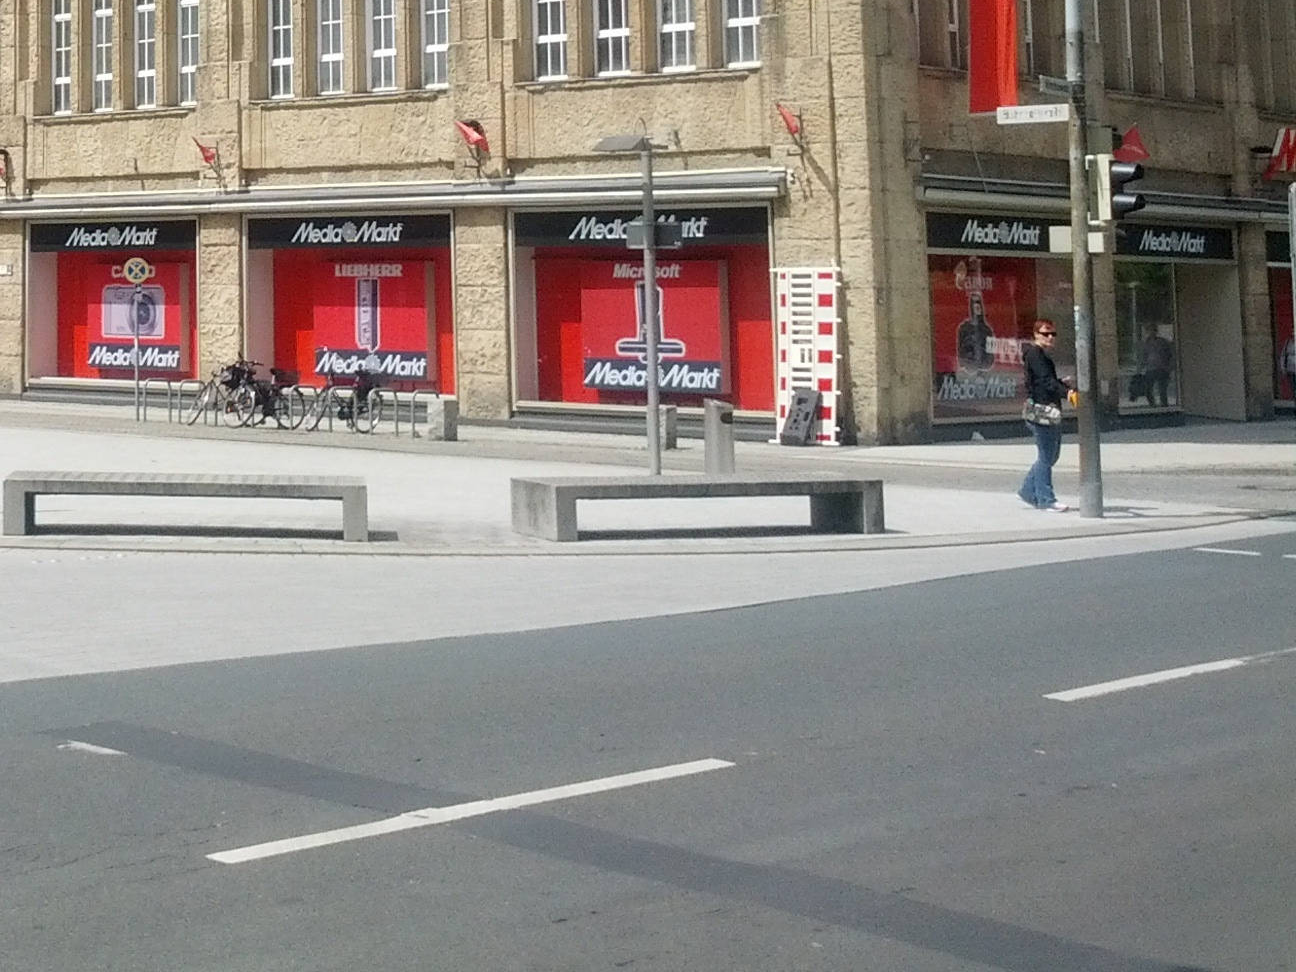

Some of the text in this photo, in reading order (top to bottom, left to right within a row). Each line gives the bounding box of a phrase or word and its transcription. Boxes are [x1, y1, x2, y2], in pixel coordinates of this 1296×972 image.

[65, 226, 157, 246] Media Markt
[291, 221, 403, 243] Media Markt
[961, 219, 1040, 245] Media Markt
[1139, 229, 1205, 253] Media Markt
[334, 264, 403, 277] LIEBHERR
[613, 263, 680, 278] Micrsoft
[87, 346, 180, 367] Media Markt
[314, 351, 427, 376] Media Markt
[584, 361, 720, 389] Media Markt
[938, 375, 976, 400] Media
